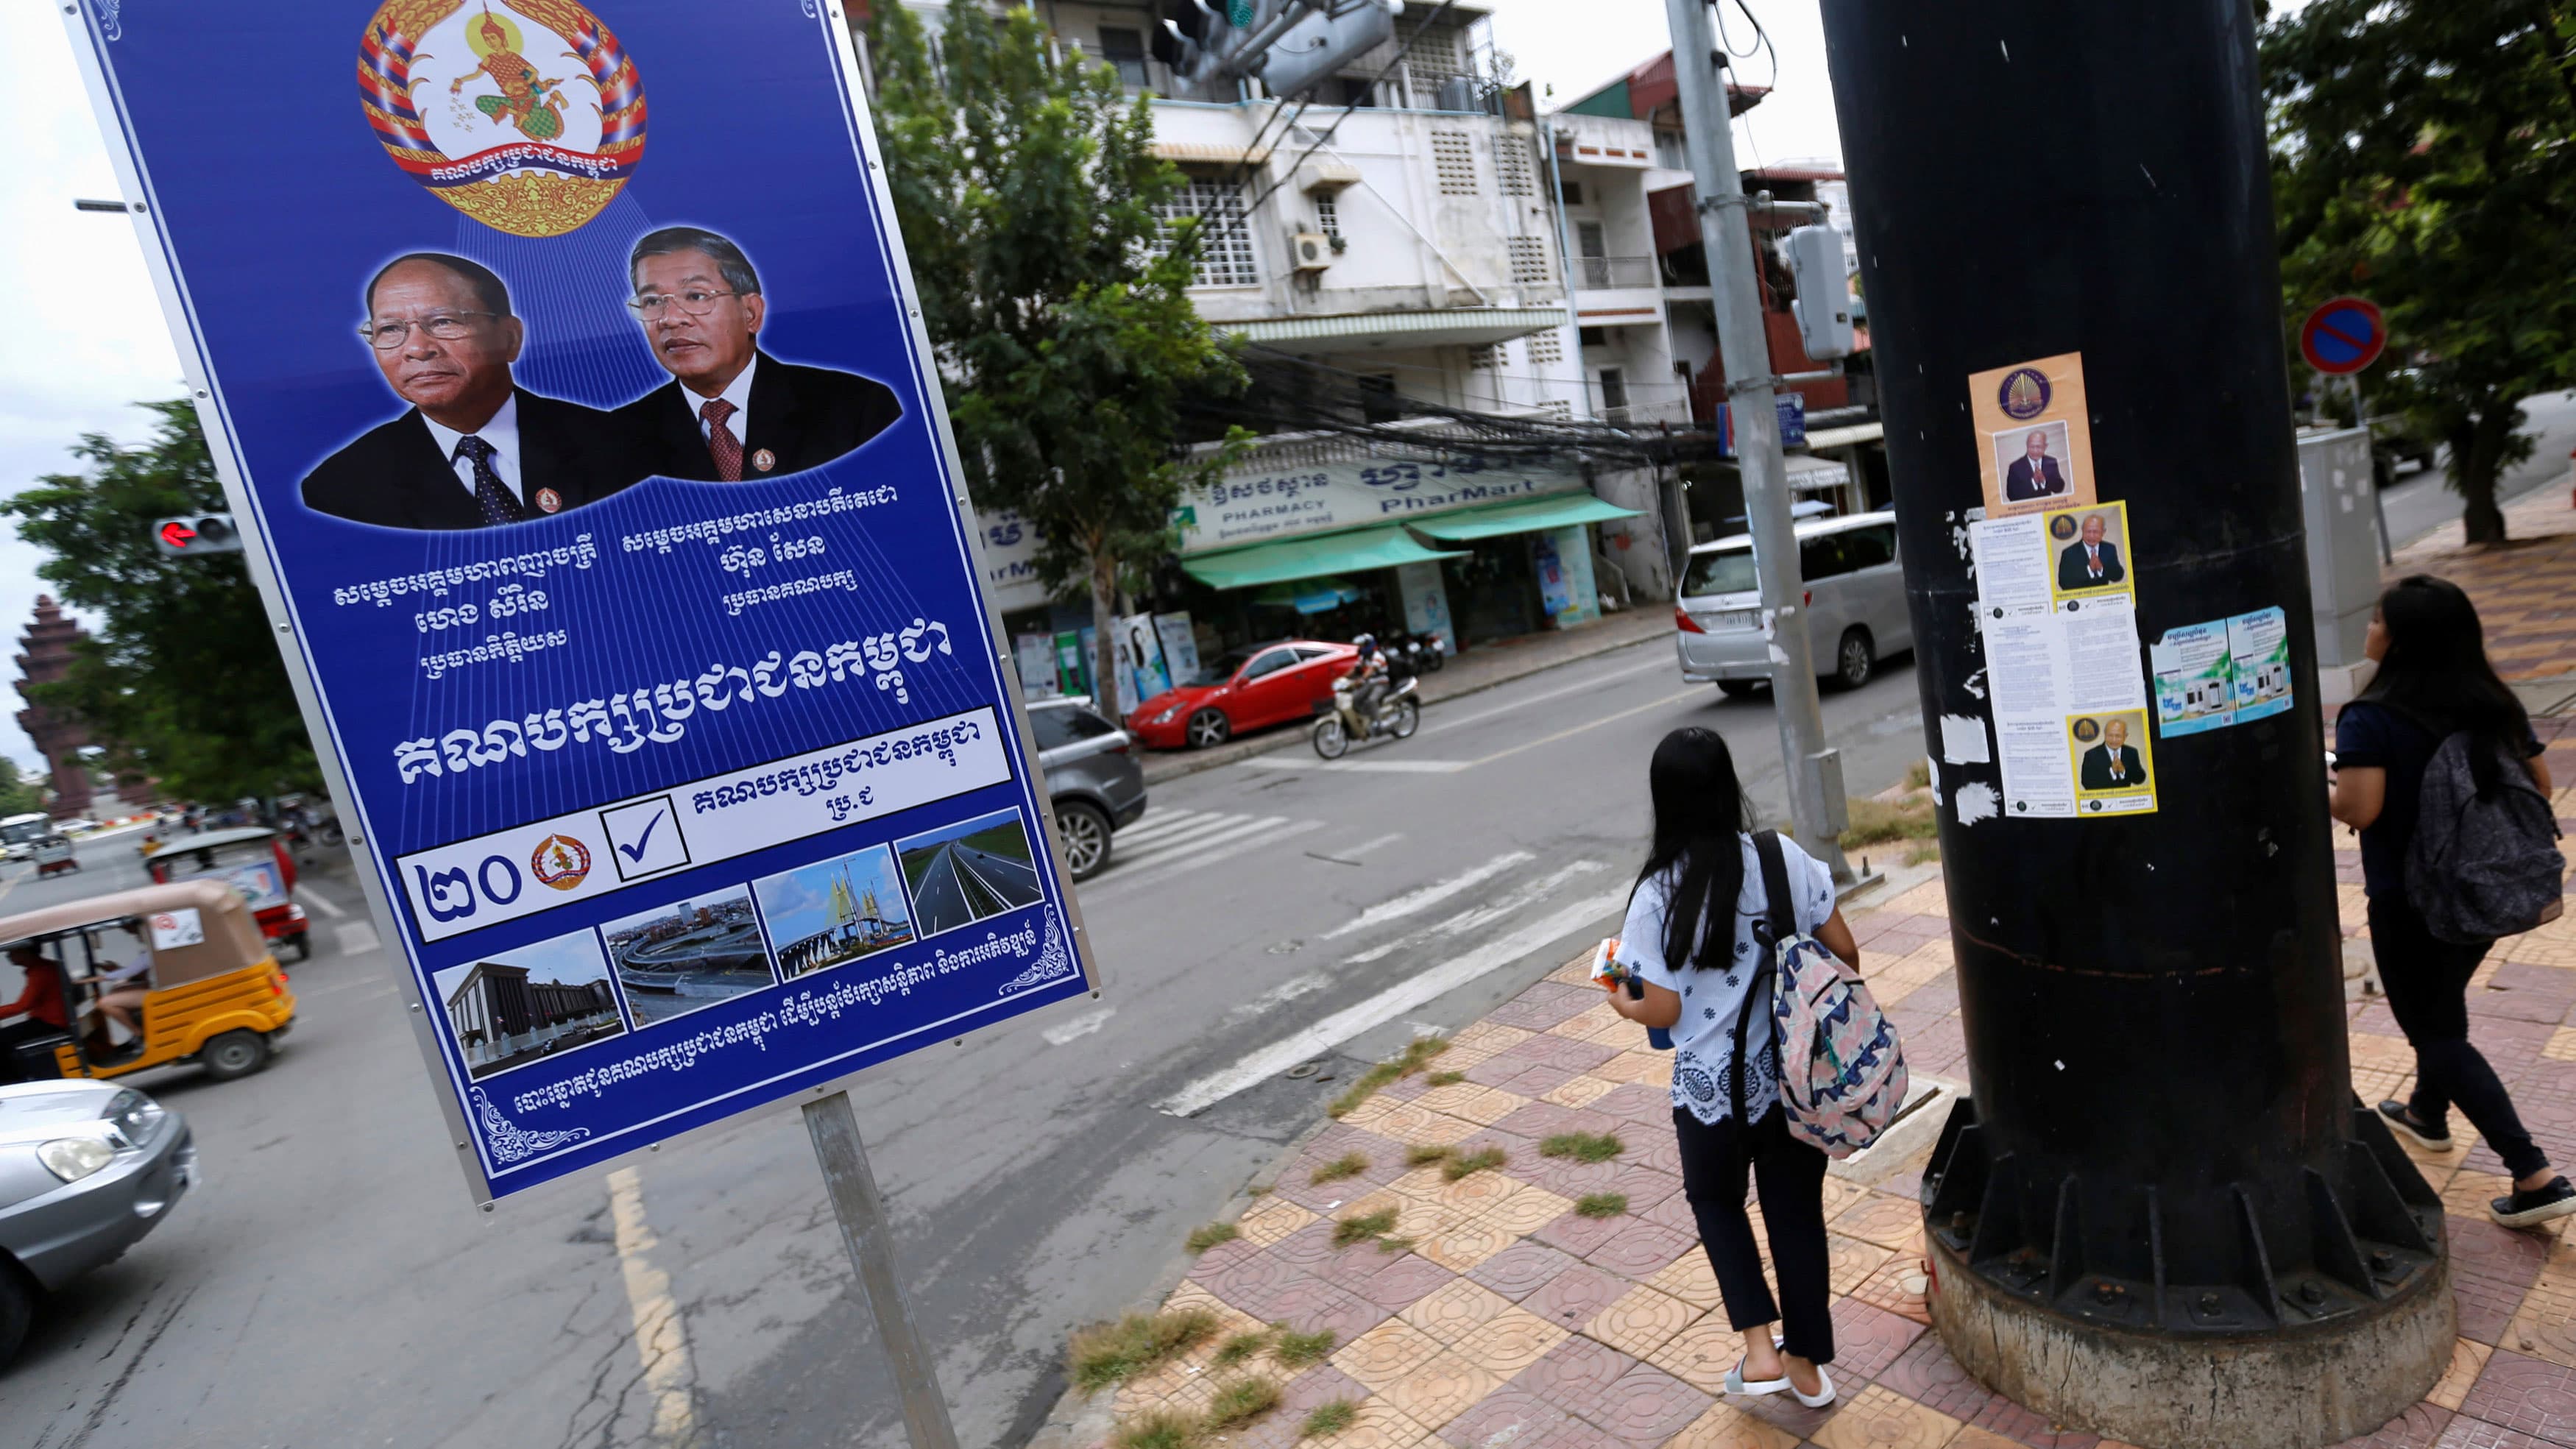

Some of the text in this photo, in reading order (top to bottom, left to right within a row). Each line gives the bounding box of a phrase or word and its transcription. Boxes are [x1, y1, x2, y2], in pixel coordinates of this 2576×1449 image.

[1222, 500, 1325, 522] PHARMACY
[1381, 478, 1535, 513] PharMart
[719, 531, 826, 578] ហ៊ុន សែន
[414, 583, 549, 634] ហេង សំរិន
[722, 568, 858, 617] ប្រធានគណបក្ស
[392, 617, 953, 784] គណបក្សប្រជាជនកម្ពុជា
[692, 720, 983, 815] គណបក្សប្រជាជនកម្ពុជា
[414, 854, 523, 924] ២០
